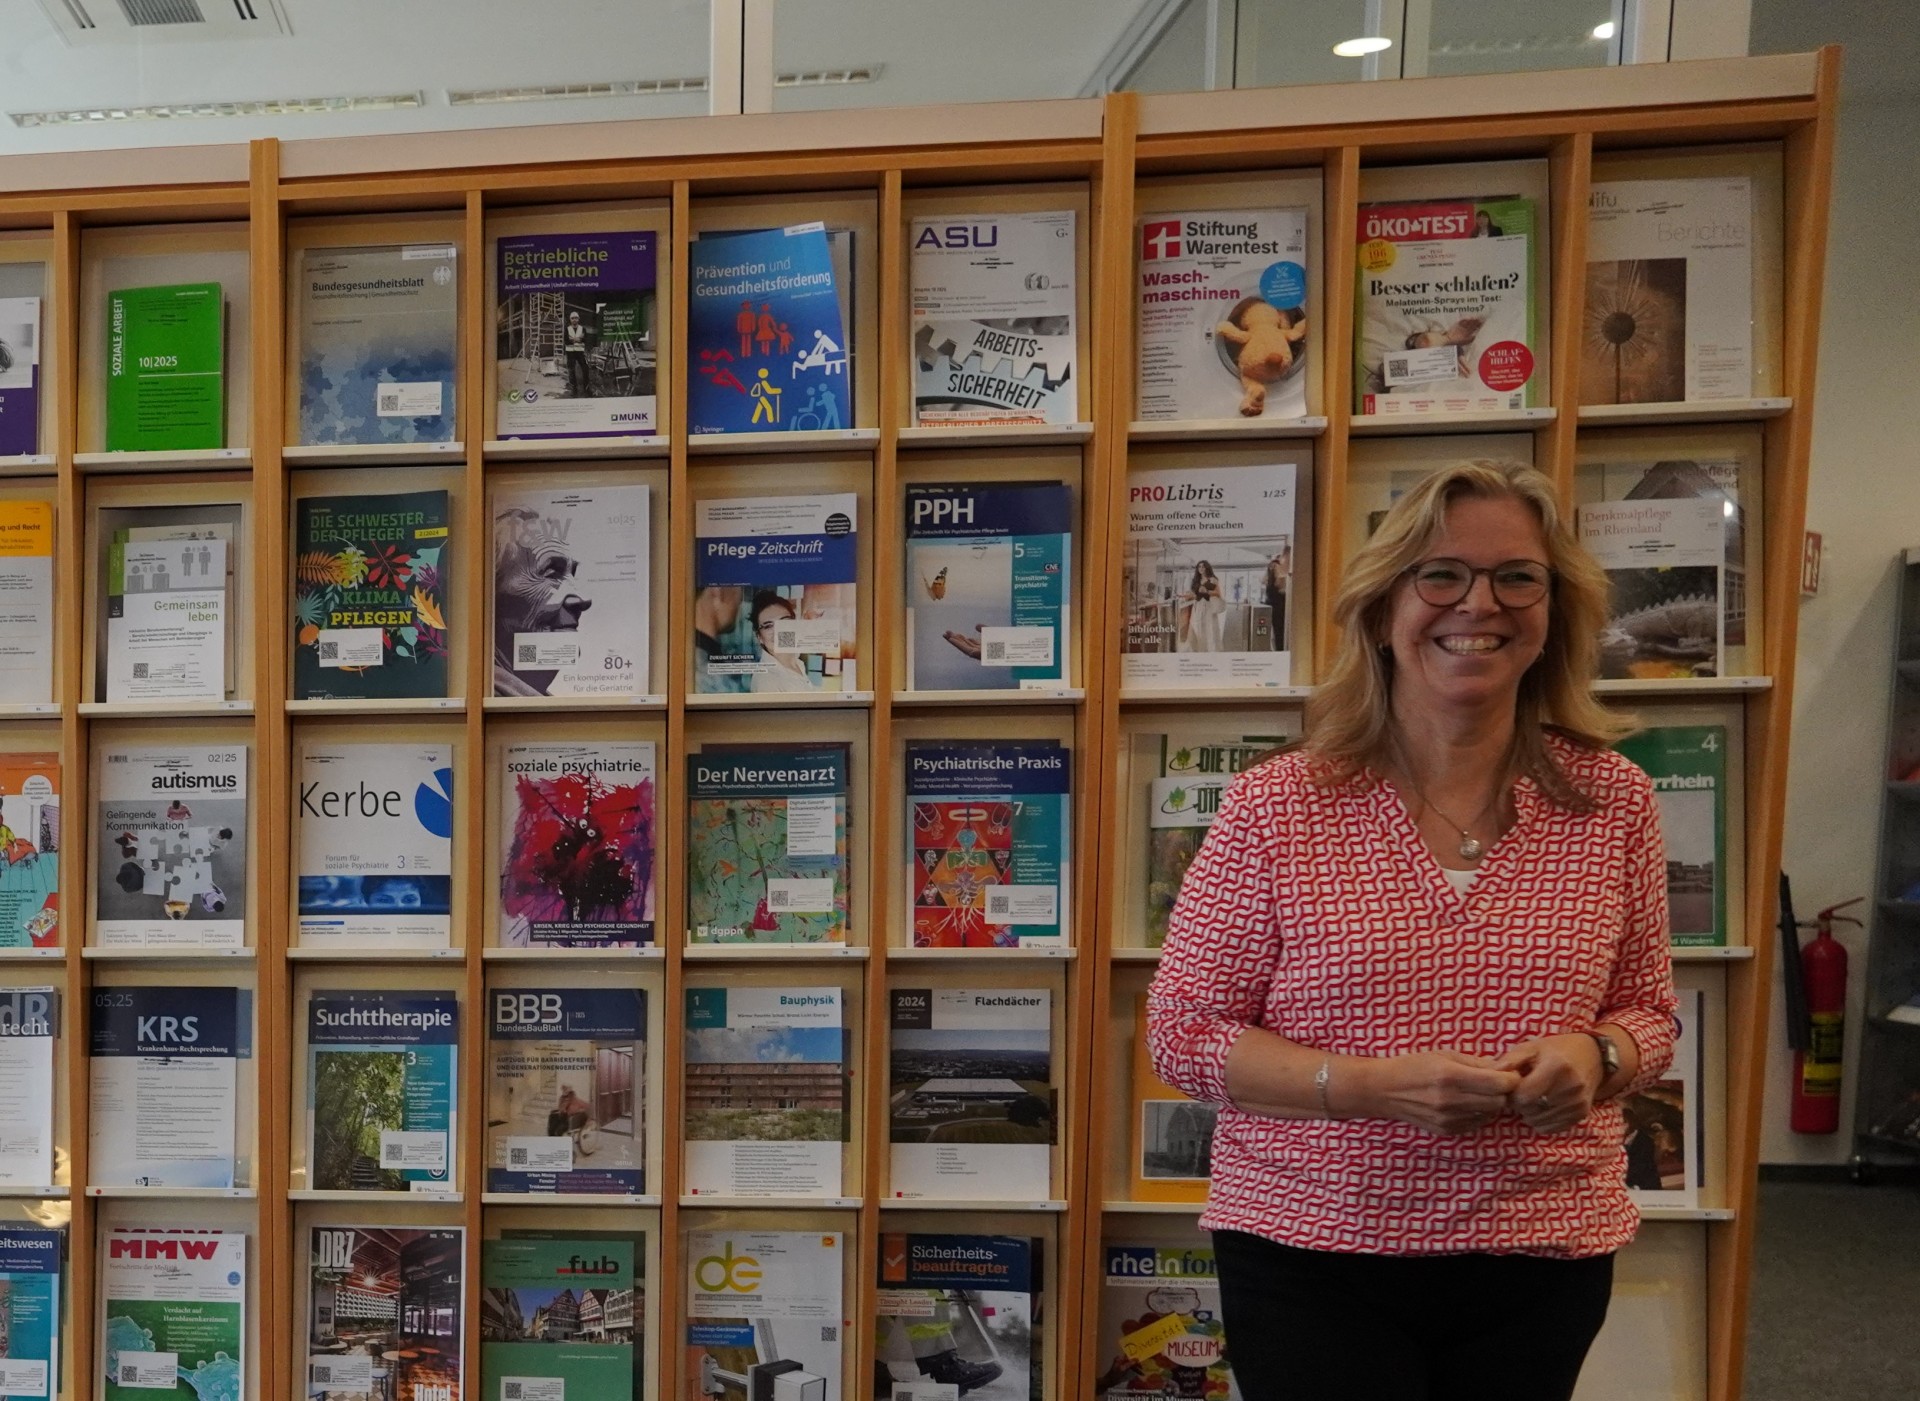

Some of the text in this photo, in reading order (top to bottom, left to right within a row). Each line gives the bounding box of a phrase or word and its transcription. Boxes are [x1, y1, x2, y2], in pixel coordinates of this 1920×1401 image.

[1186, 222, 1258, 238] Stiftung
[1366, 214, 1468, 238] ÖKO TEST
[914, 225, 998, 249] ASU
[1186, 240, 1278, 254] Warentest
[504, 248, 608, 266] Betriebliche
[504, 264, 598, 280] Prävention
[696, 256, 791, 279] Prävention und
[312, 278, 424, 292] Bundesgesundheitsblatt
[696, 272, 831, 296] Gesundheitsförderung
[1143, 270, 1209, 286] Wasch-
[1370, 272, 1519, 296] Besser schlafen?
[1142, 286, 1240, 304] maschinen
[1386, 295, 1465, 308] Melatonin-Sprays
[1402, 304, 1484, 316] Wirklich harmlos?
[112, 299, 123, 376] SOZIALE ARBEIT
[973, 328, 1043, 358] ARBEITS-
[948, 373, 1046, 409] SICHERHEIT
[619, 412, 648, 421] MUNK
[914, 498, 974, 524] PPH
[1130, 511, 1221, 521] Warum offene Orte
[1585, 508, 1672, 524] Denkmalpflege
[310, 512, 424, 528] DIE SCHWESTER
[1130, 521, 1244, 532] klare Grenzen brauchen
[310, 528, 405, 542] DER PFLEGER
[1585, 522, 1662, 537] im Rheinland
[708, 540, 824, 558] Pflege Zeitschrift
[1014, 543, 1025, 558] 5
[342, 590, 402, 604] KLIMA
[154, 600, 218, 610] Gemeinsam
[188, 612, 218, 622] leben
[330, 610, 412, 626] PFLEGEN
[1128, 624, 1176, 635] Bibliothek
[1144, 635, 1161, 644] alle
[604, 656, 633, 670] 80+
[564, 672, 634, 683] Ein komplexer Fall
[574, 684, 633, 692] für die Geriatrie
[1702, 734, 1718, 752] 4
[208, 753, 237, 764] 02|25
[914, 756, 1062, 773] Psychiatrische Praxis
[1199, 747, 1224, 773] DIE
[508, 759, 642, 774] soziale psychiatrie
[152, 771, 236, 789] autismus
[697, 766, 835, 783] Der Nervenarzt
[1652, 774, 1715, 789] rrhein
[300, 781, 401, 818] Kerbe
[106, 810, 156, 820] Gelingende
[1013, 801, 1023, 816] 7
[106, 821, 184, 831] Kommunikation
[349, 854, 360, 862] für
[397, 856, 406, 869] 3
[351, 861, 389, 871] Psychiatrie
[711, 926, 743, 936] dgppn
[1680, 937, 1715, 946] Wandern
[95, 994, 133, 1008] 05.25
[694, 996, 699, 1006] 1
[780, 996, 834, 1006] Bauphysik
[898, 997, 925, 1007] 2024
[975, 996, 1042, 1006] Flachdächer
[496, 994, 562, 1024] BBB
[316, 1008, 452, 1031] Suchttherapie
[137, 1016, 199, 1043] KRS
[496, 1024, 562, 1032] BundesBauBlatt
[137, 1045, 228, 1054] Krankenhaus-Rechtsprechung
[407, 1052, 416, 1066] 3
[110, 1239, 219, 1260] MMW
[319, 1231, 355, 1269] DBZ
[912, 1246, 998, 1260] Sicherheits-
[569, 1255, 620, 1274] fub
[694, 1240, 762, 1293] de
[913, 1260, 1009, 1275] beauftragter
[1168, 1340, 1220, 1357] MUSEUM
[414, 1384, 451, 1401] Hotel
